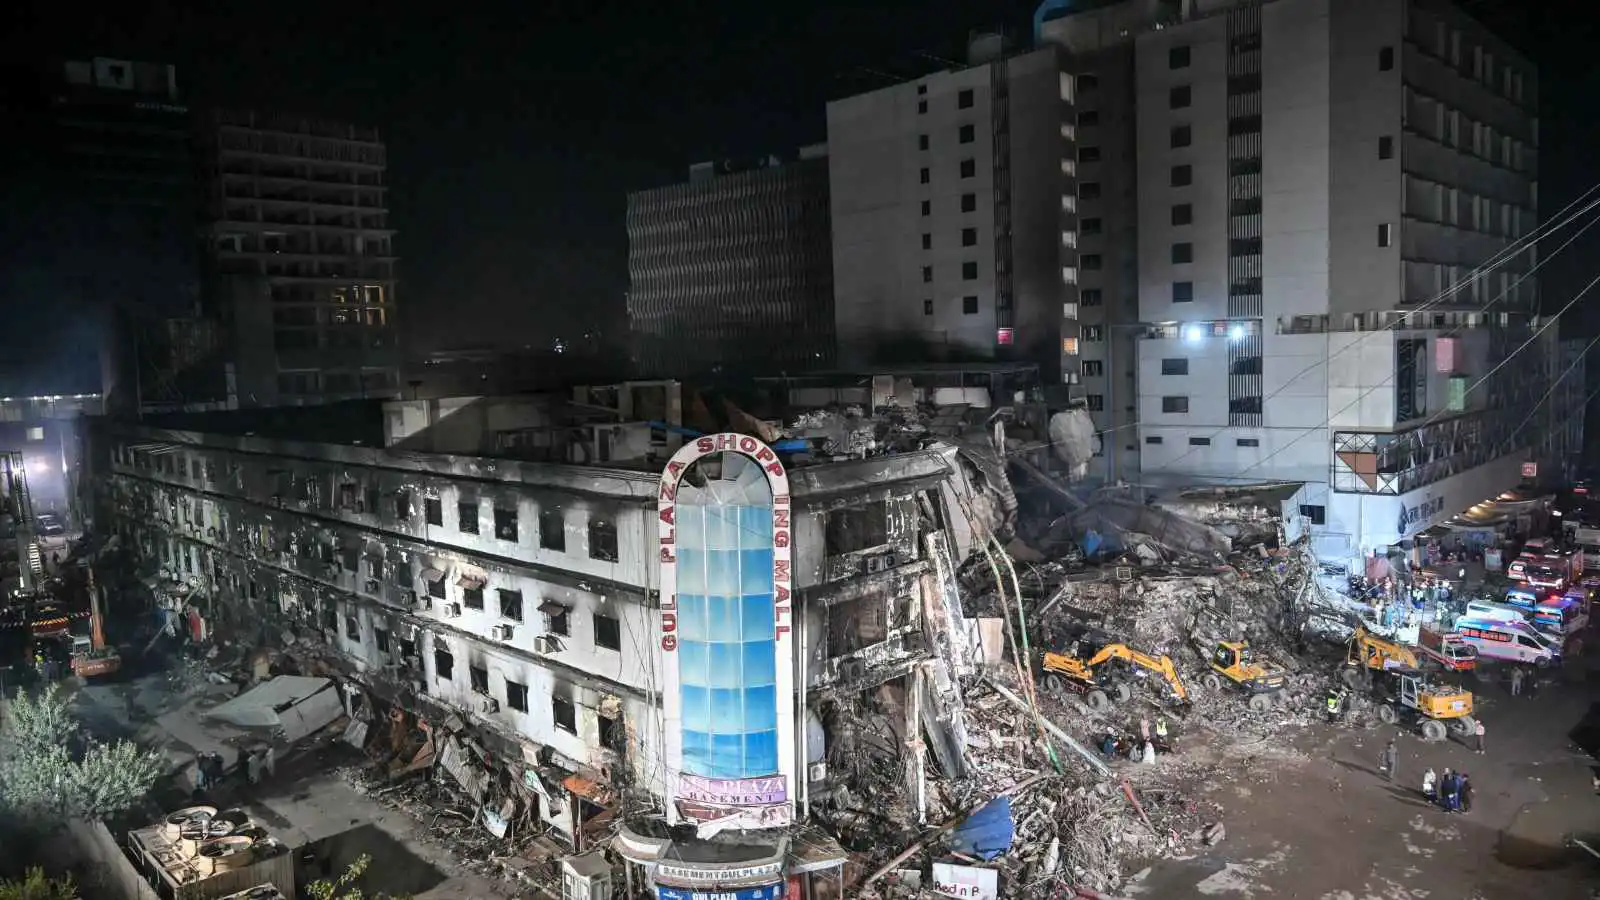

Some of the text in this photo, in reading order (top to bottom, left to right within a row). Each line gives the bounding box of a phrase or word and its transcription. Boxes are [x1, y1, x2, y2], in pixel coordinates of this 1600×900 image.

[660, 461, 685, 563] PLAZA
[661, 594, 677, 652] GUL
[774, 560, 790, 641] MALL
[689, 791, 776, 804] BASEMENT
[720, 777, 784, 793] PLAZA
